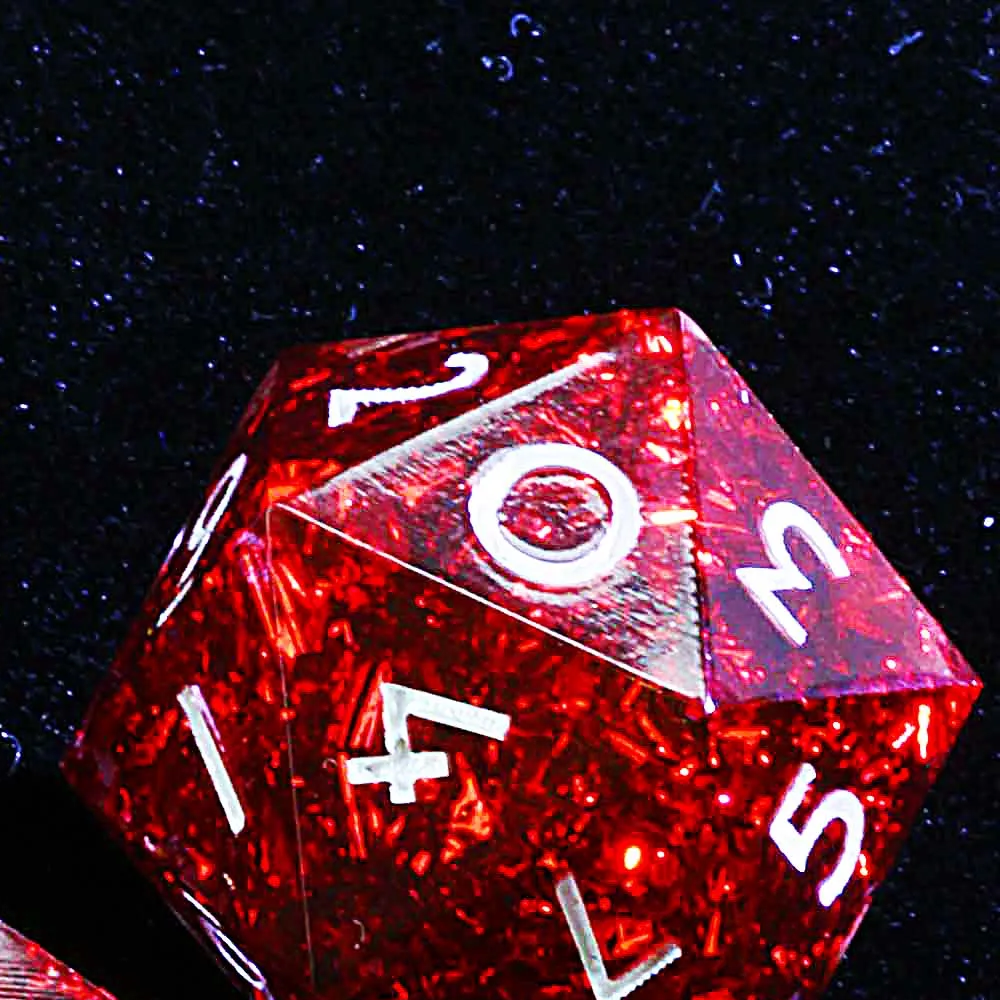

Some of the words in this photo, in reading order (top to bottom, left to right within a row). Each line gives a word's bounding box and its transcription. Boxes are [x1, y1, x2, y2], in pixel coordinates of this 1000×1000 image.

[327, 352, 489, 428] 2
[467, 443, 642, 588] 0
[735, 500, 851, 646] 3
[177, 684, 246, 835] 1
[346, 682, 511, 804] 4
[768, 763, 865, 907] 5
